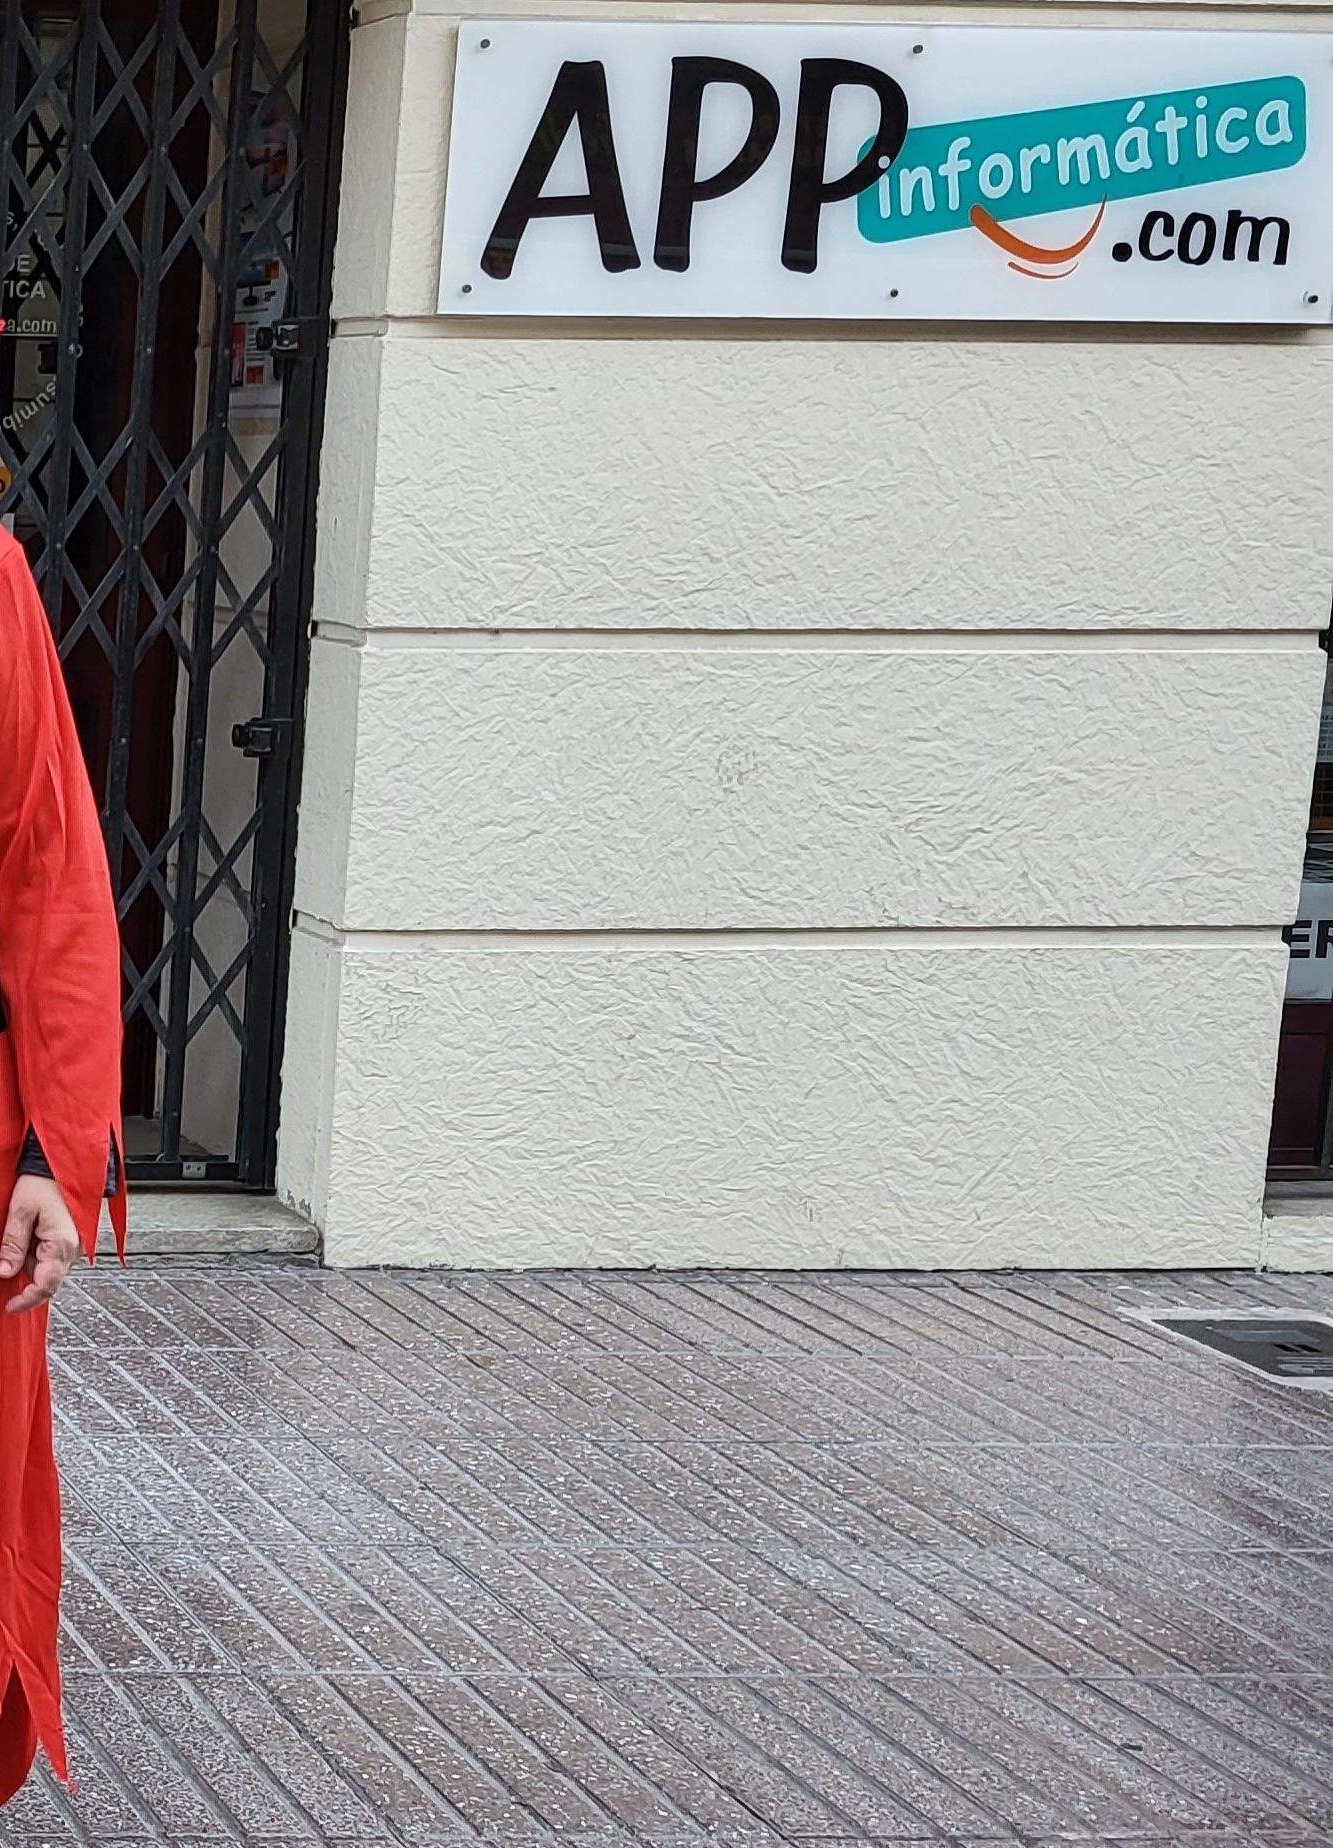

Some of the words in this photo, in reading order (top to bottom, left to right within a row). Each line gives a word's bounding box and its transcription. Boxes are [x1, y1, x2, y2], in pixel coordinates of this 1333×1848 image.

[480, 56, 910, 280] APP
[877, 94, 1294, 220] informática
[1112, 207, 1291, 267] .com
